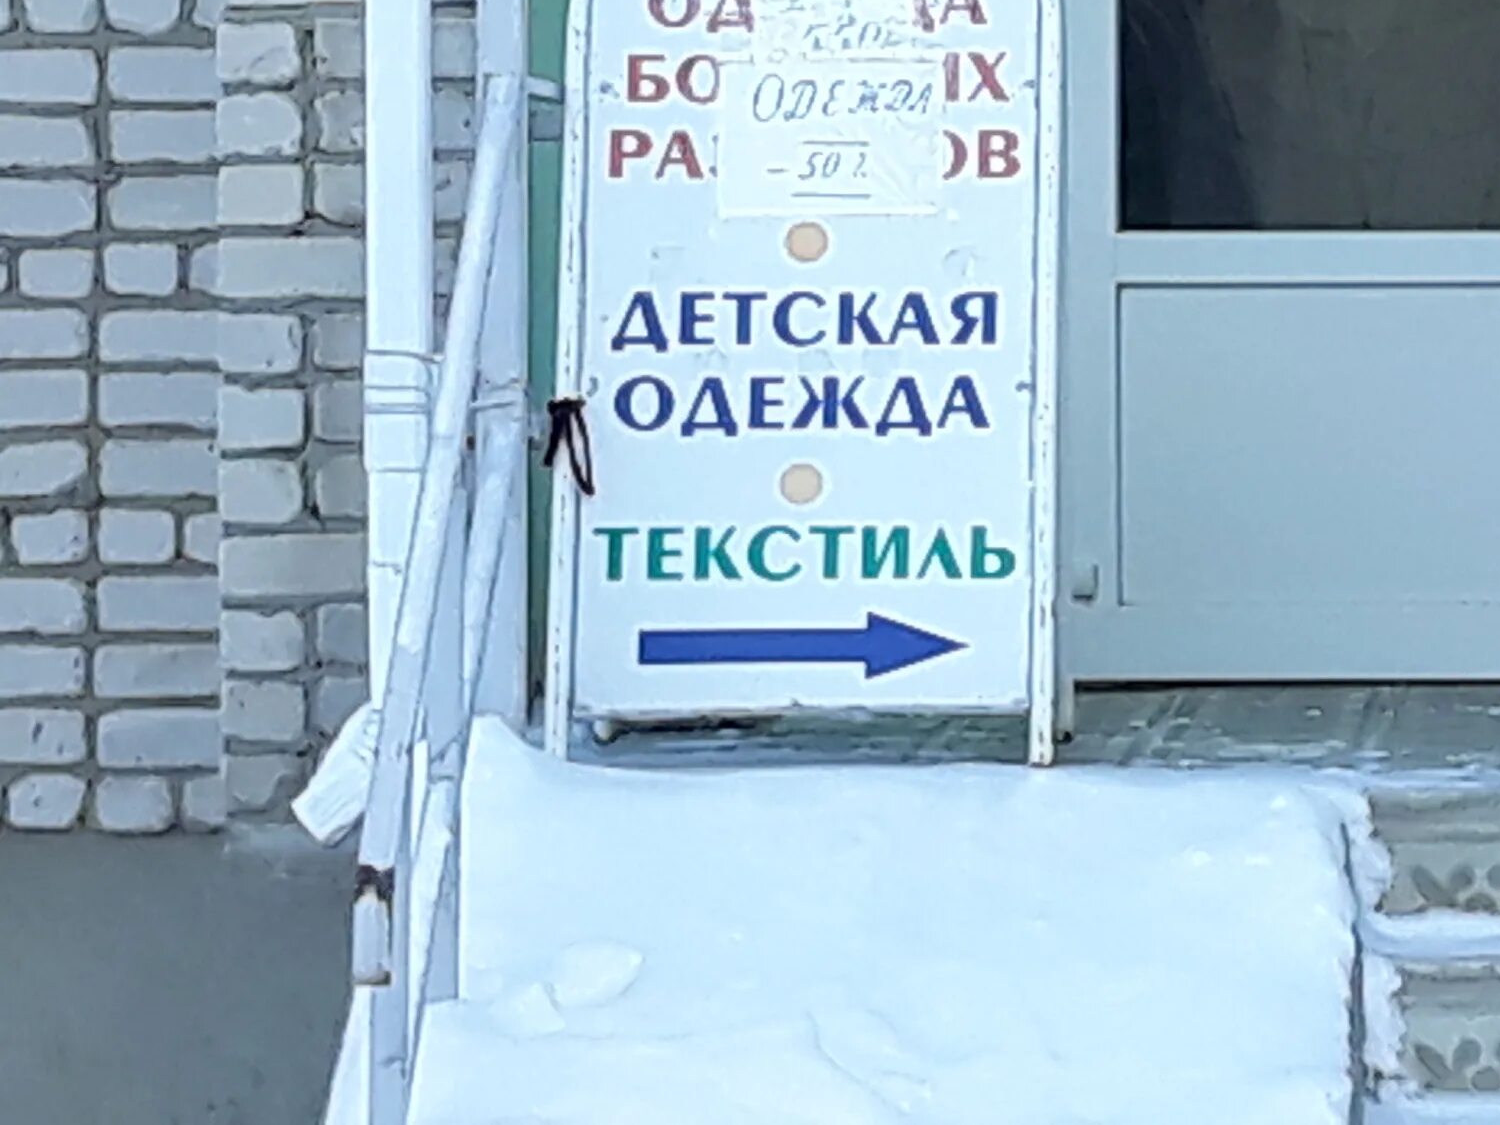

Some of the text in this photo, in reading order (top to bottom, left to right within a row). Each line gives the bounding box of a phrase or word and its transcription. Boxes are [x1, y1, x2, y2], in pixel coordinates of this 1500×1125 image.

[611, 291, 999, 352] ДЕТСКАЯ
[613, 375, 991, 436] ОДЕЖДА
[593, 525, 1016, 581] ТЕКСТИЛЬ
